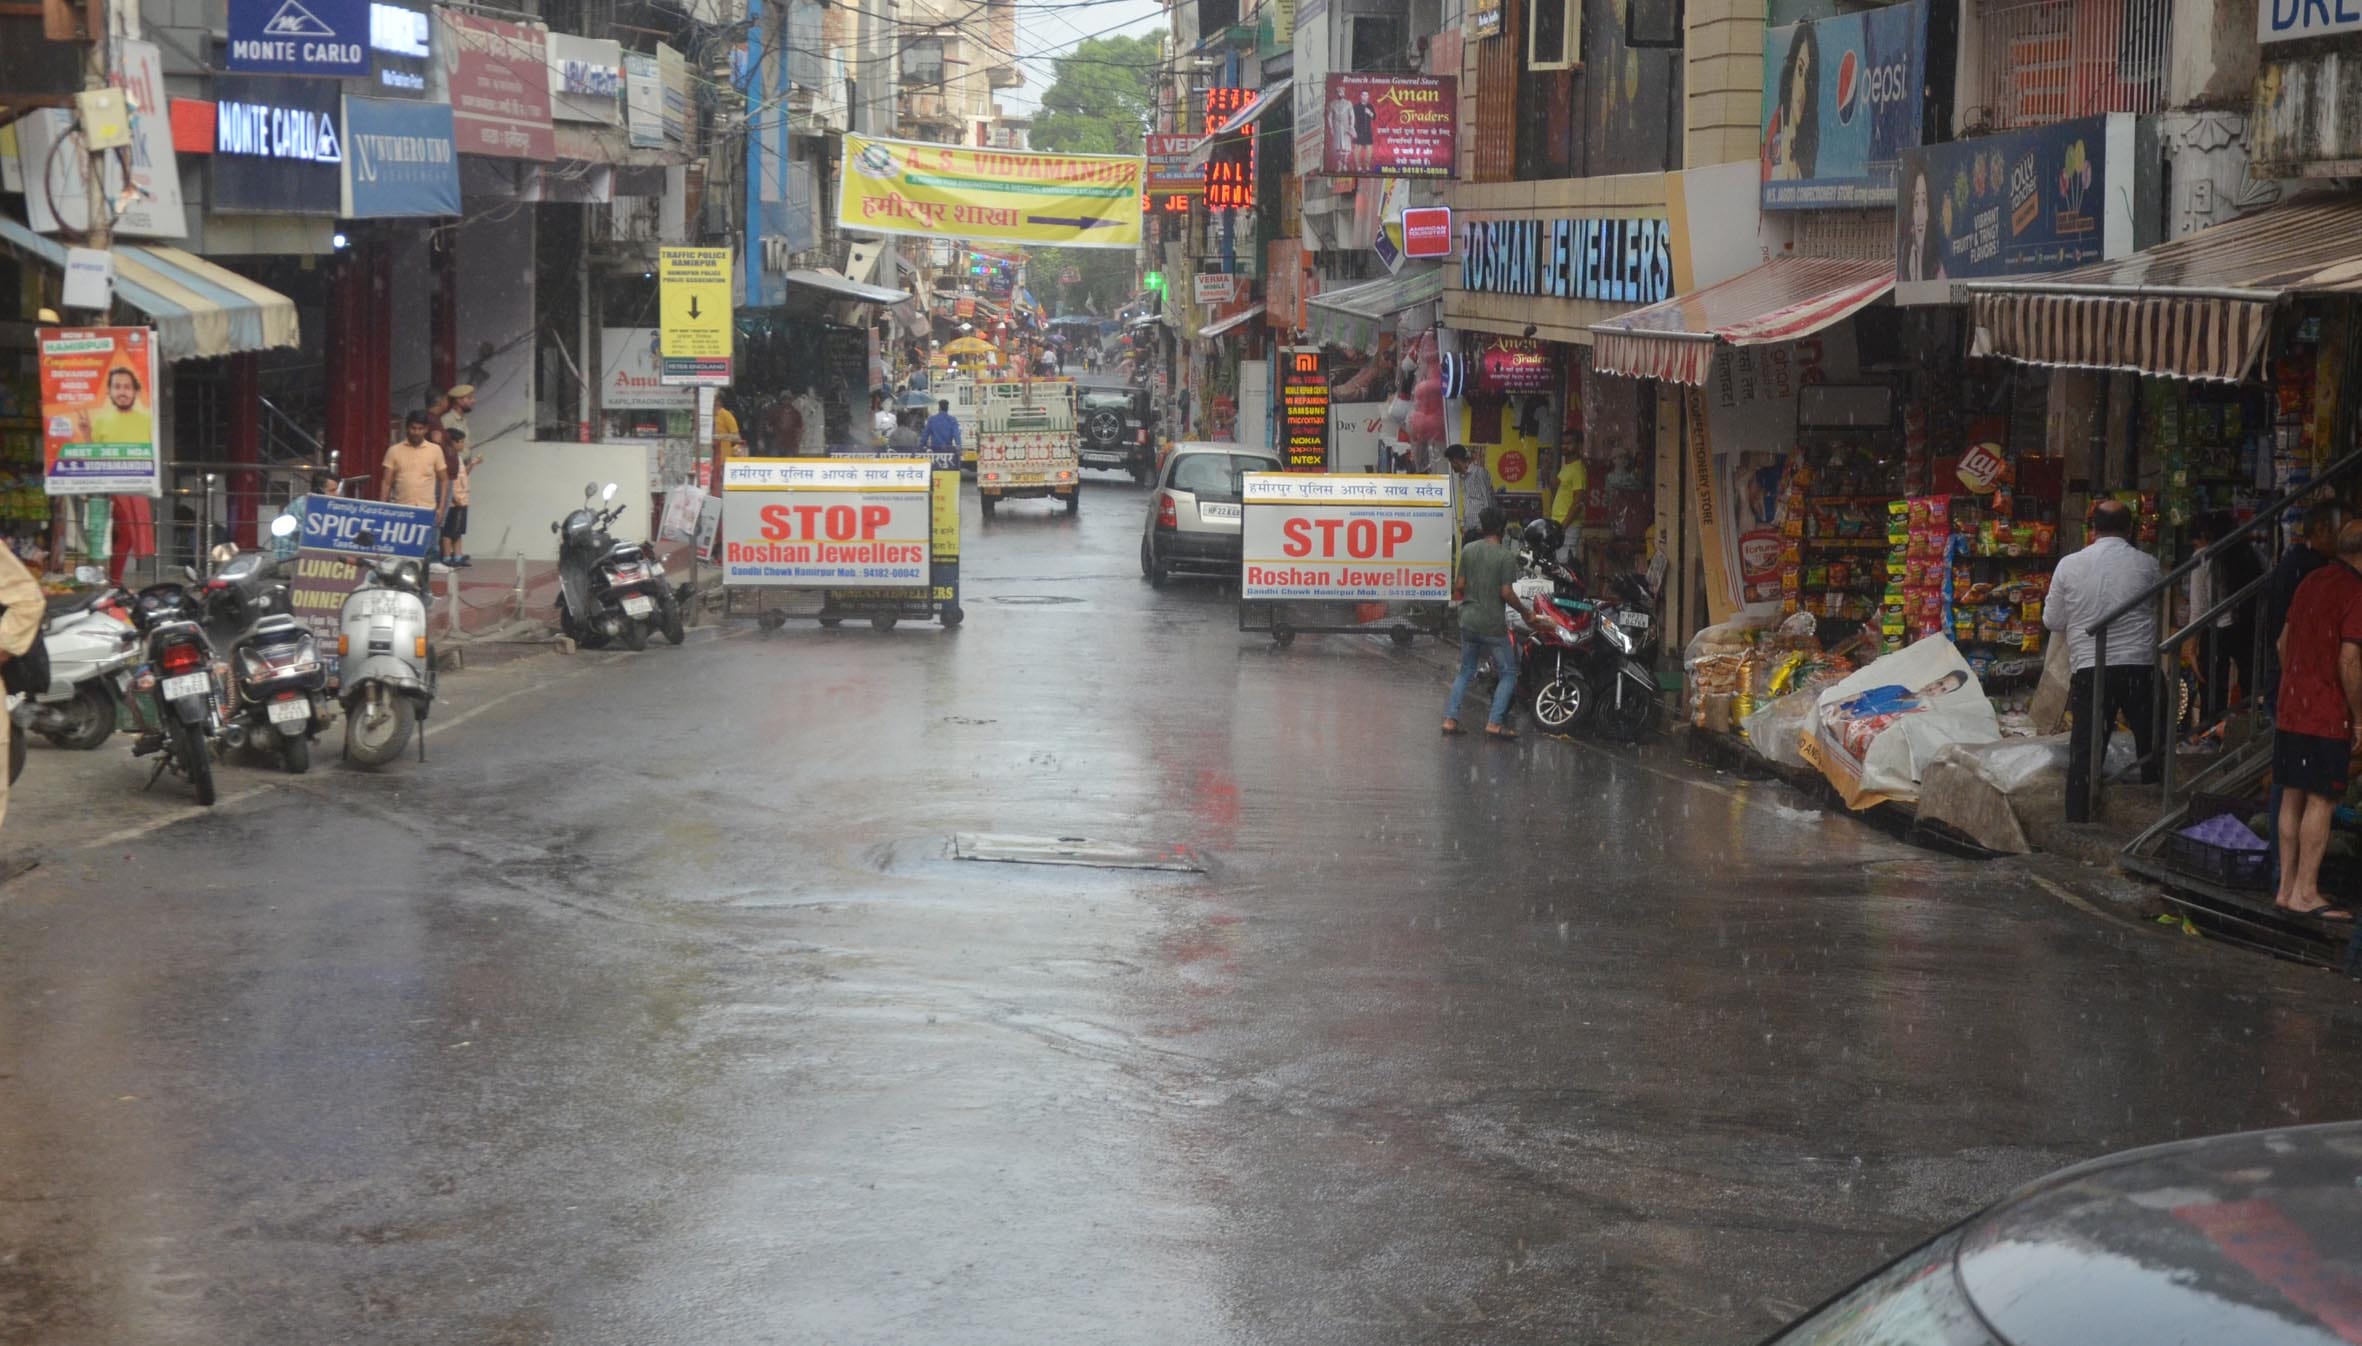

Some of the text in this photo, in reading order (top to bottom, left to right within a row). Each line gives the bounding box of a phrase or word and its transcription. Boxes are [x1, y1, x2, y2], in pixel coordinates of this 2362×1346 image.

[233, 40, 362, 63] MONTE CARLO
[1343, 76, 1368, 84] Branch
[1392, 77, 1419, 85] General
[1420, 78, 1439, 86] Store
[1860, 54, 1907, 114] pepsi
[1377, 86, 1439, 106] Aman
[1400, 110, 1449, 124] Traders
[218, 99, 317, 160] MONTE CARLO
[375, 135, 450, 163] NUMERO UNO
[1163, 137, 1201, 152] VER
[974, 153, 1138, 183] VIDYAMANDIR
[2010, 152, 2034, 198] JOLLY
[862, 192, 1021, 228] हमीरपुर शाखा
[1974, 206, 1999, 230] VIBRANT
[1953, 232, 1974, 256] FRUITY
[1979, 224, 1999, 246] TANGY
[662, 251, 696, 259] TRAFFIC
[671, 259, 717, 267] HAMIRPUR
[1461, 218, 1670, 303] ROSHAN JEWELLERS
[1200, 275, 1230, 284] VERMA
[1488, 336, 1537, 353] Aman
[1288, 406, 1326, 415] SAMSUNG
[1288, 416, 1325, 424] micromax
[1290, 437, 1321, 445] NOKIA
[1690, 396, 1714, 526] CONFECTIONERY STORE
[730, 466, 924, 484] हमीरपुर पुलिस आपके साथ सदैव
[1249, 480, 1443, 497] हमीरपुर पुलिस आपके साथ सदैव
[327, 502, 416, 519] Family Restaurant
[305, 512, 431, 547] SPICE-HUT
[760, 504, 892, 541] STOP
[1283, 517, 1413, 559] STOP
[728, 542, 812, 564] Roshan
[816, 542, 923, 565] Jewellers
[297, 558, 358, 581] LUNCH
[731, 566, 762, 576] Gandhi
[763, 566, 793, 577] Chowk
[794, 567, 835, 578] Hamirpur
[863, 568, 920, 578] 94182-00042
[1248, 566, 1447, 587] Roshan Jewellers
[1313, 588, 1355, 597] Hamirpur
[1388, 589, 1448, 597] 94182-00042
